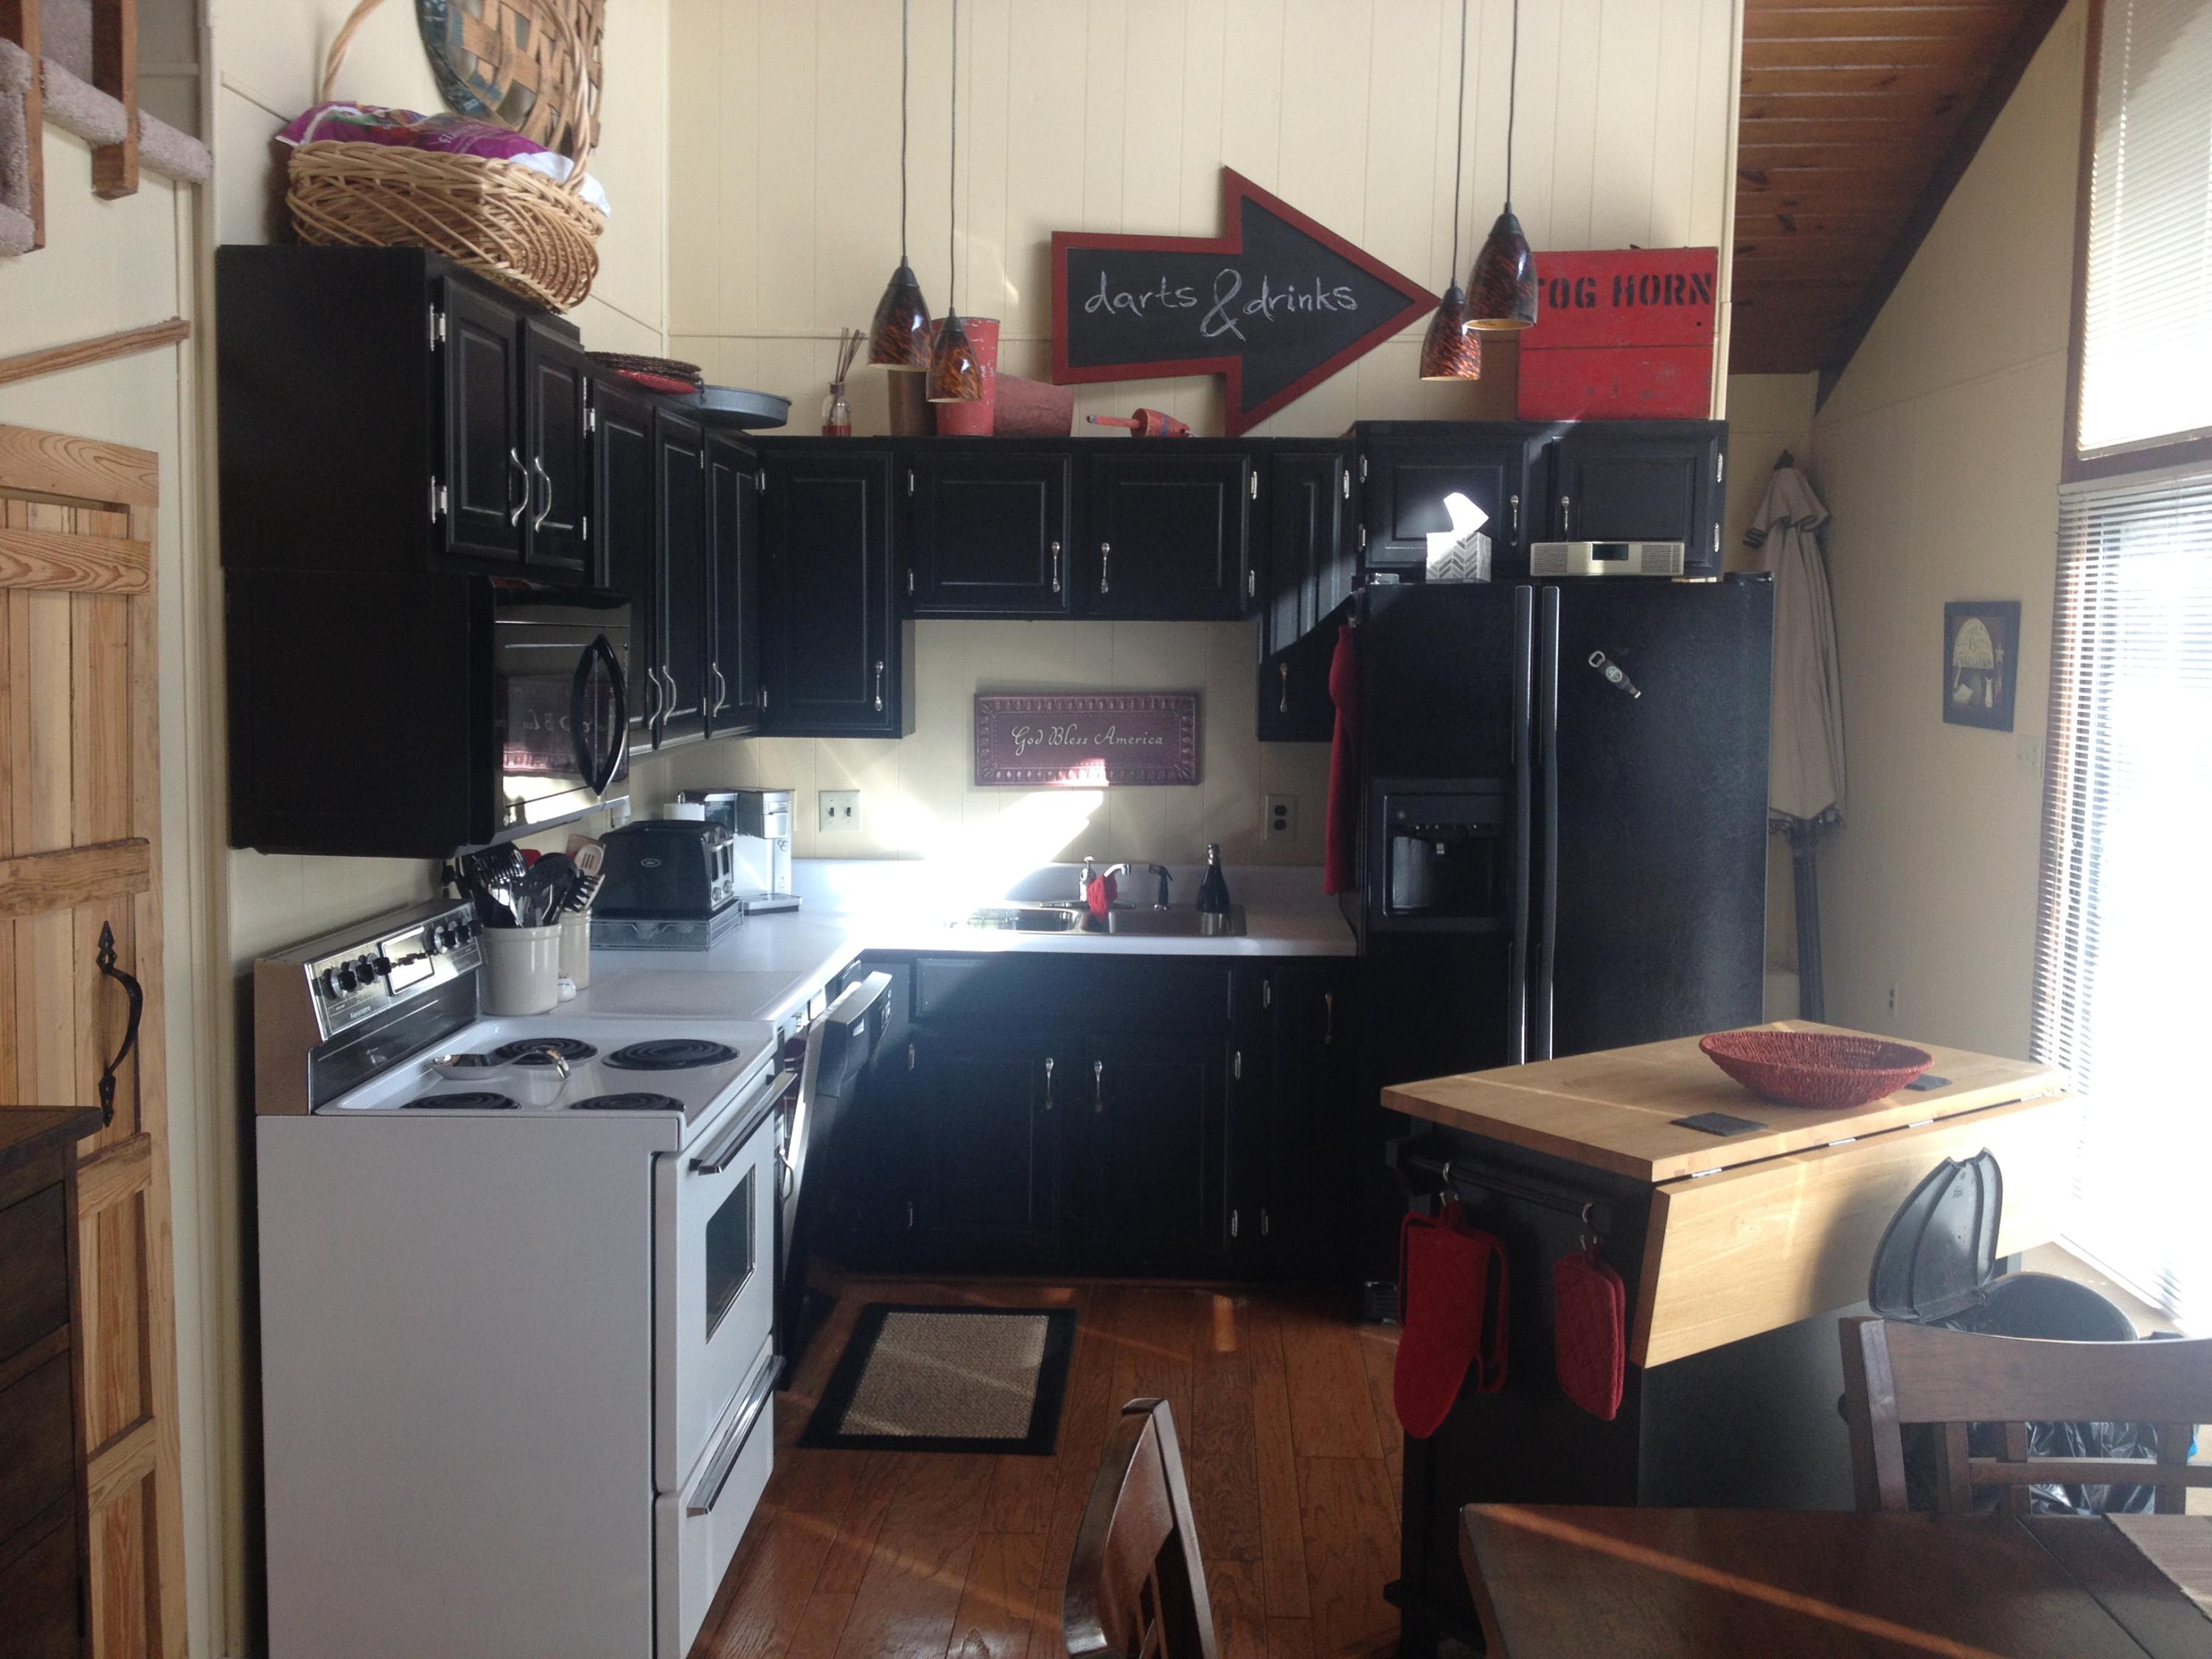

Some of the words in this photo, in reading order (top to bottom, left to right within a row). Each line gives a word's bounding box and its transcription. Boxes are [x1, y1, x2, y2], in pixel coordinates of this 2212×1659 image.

[1085, 270, 1199, 316] darts
[1200, 268, 1246, 341] &
[1243, 274, 1358, 321] drinks
[1538, 276, 1596, 310] OG
[1612, 273, 1712, 307] HORN
[1011, 726, 1043, 756] God
[1048, 723, 1088, 745] Bless
[1093, 726, 1163, 745] America
